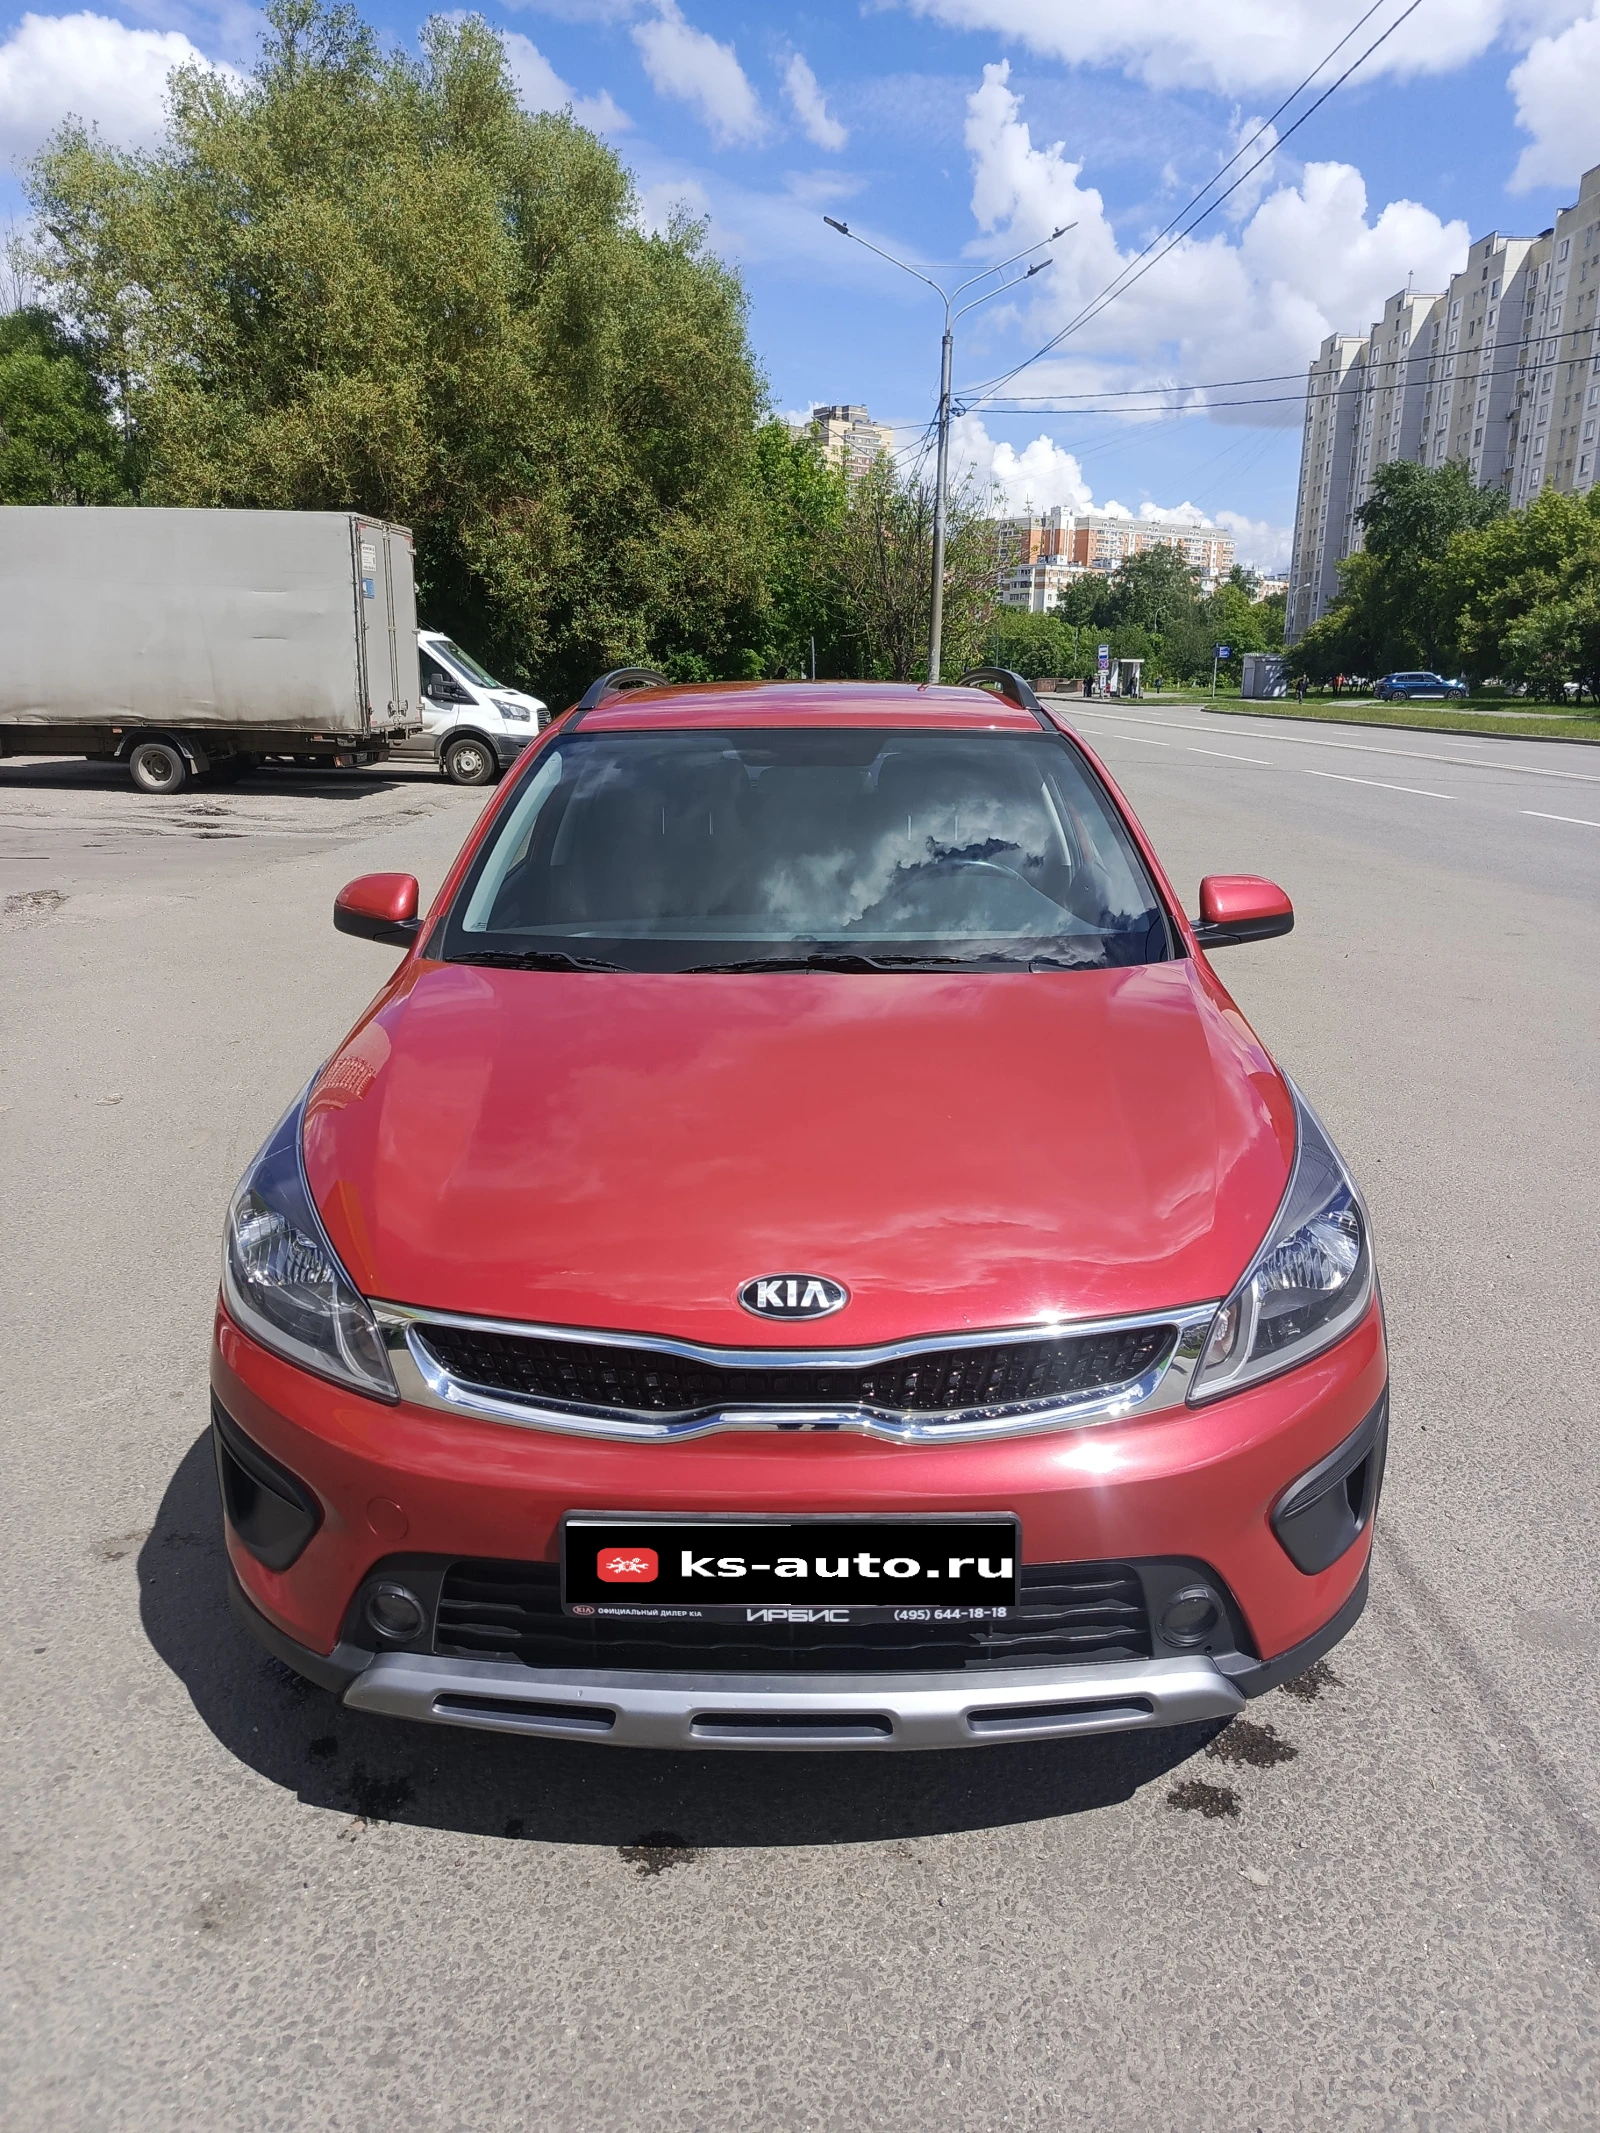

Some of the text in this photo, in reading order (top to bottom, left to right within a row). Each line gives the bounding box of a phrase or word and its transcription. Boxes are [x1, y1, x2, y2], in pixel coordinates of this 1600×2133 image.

[757, 1280, 830, 1308] KIA
[598, 1607, 658, 1616] ОФИЦИАЛЬНЫЙ
[660, 1609, 687, 1617] ДИЛЕР
[746, 1608, 850, 1623] ИРБИС
[894, 1606, 1007, 1621] (495) 644-18-18
